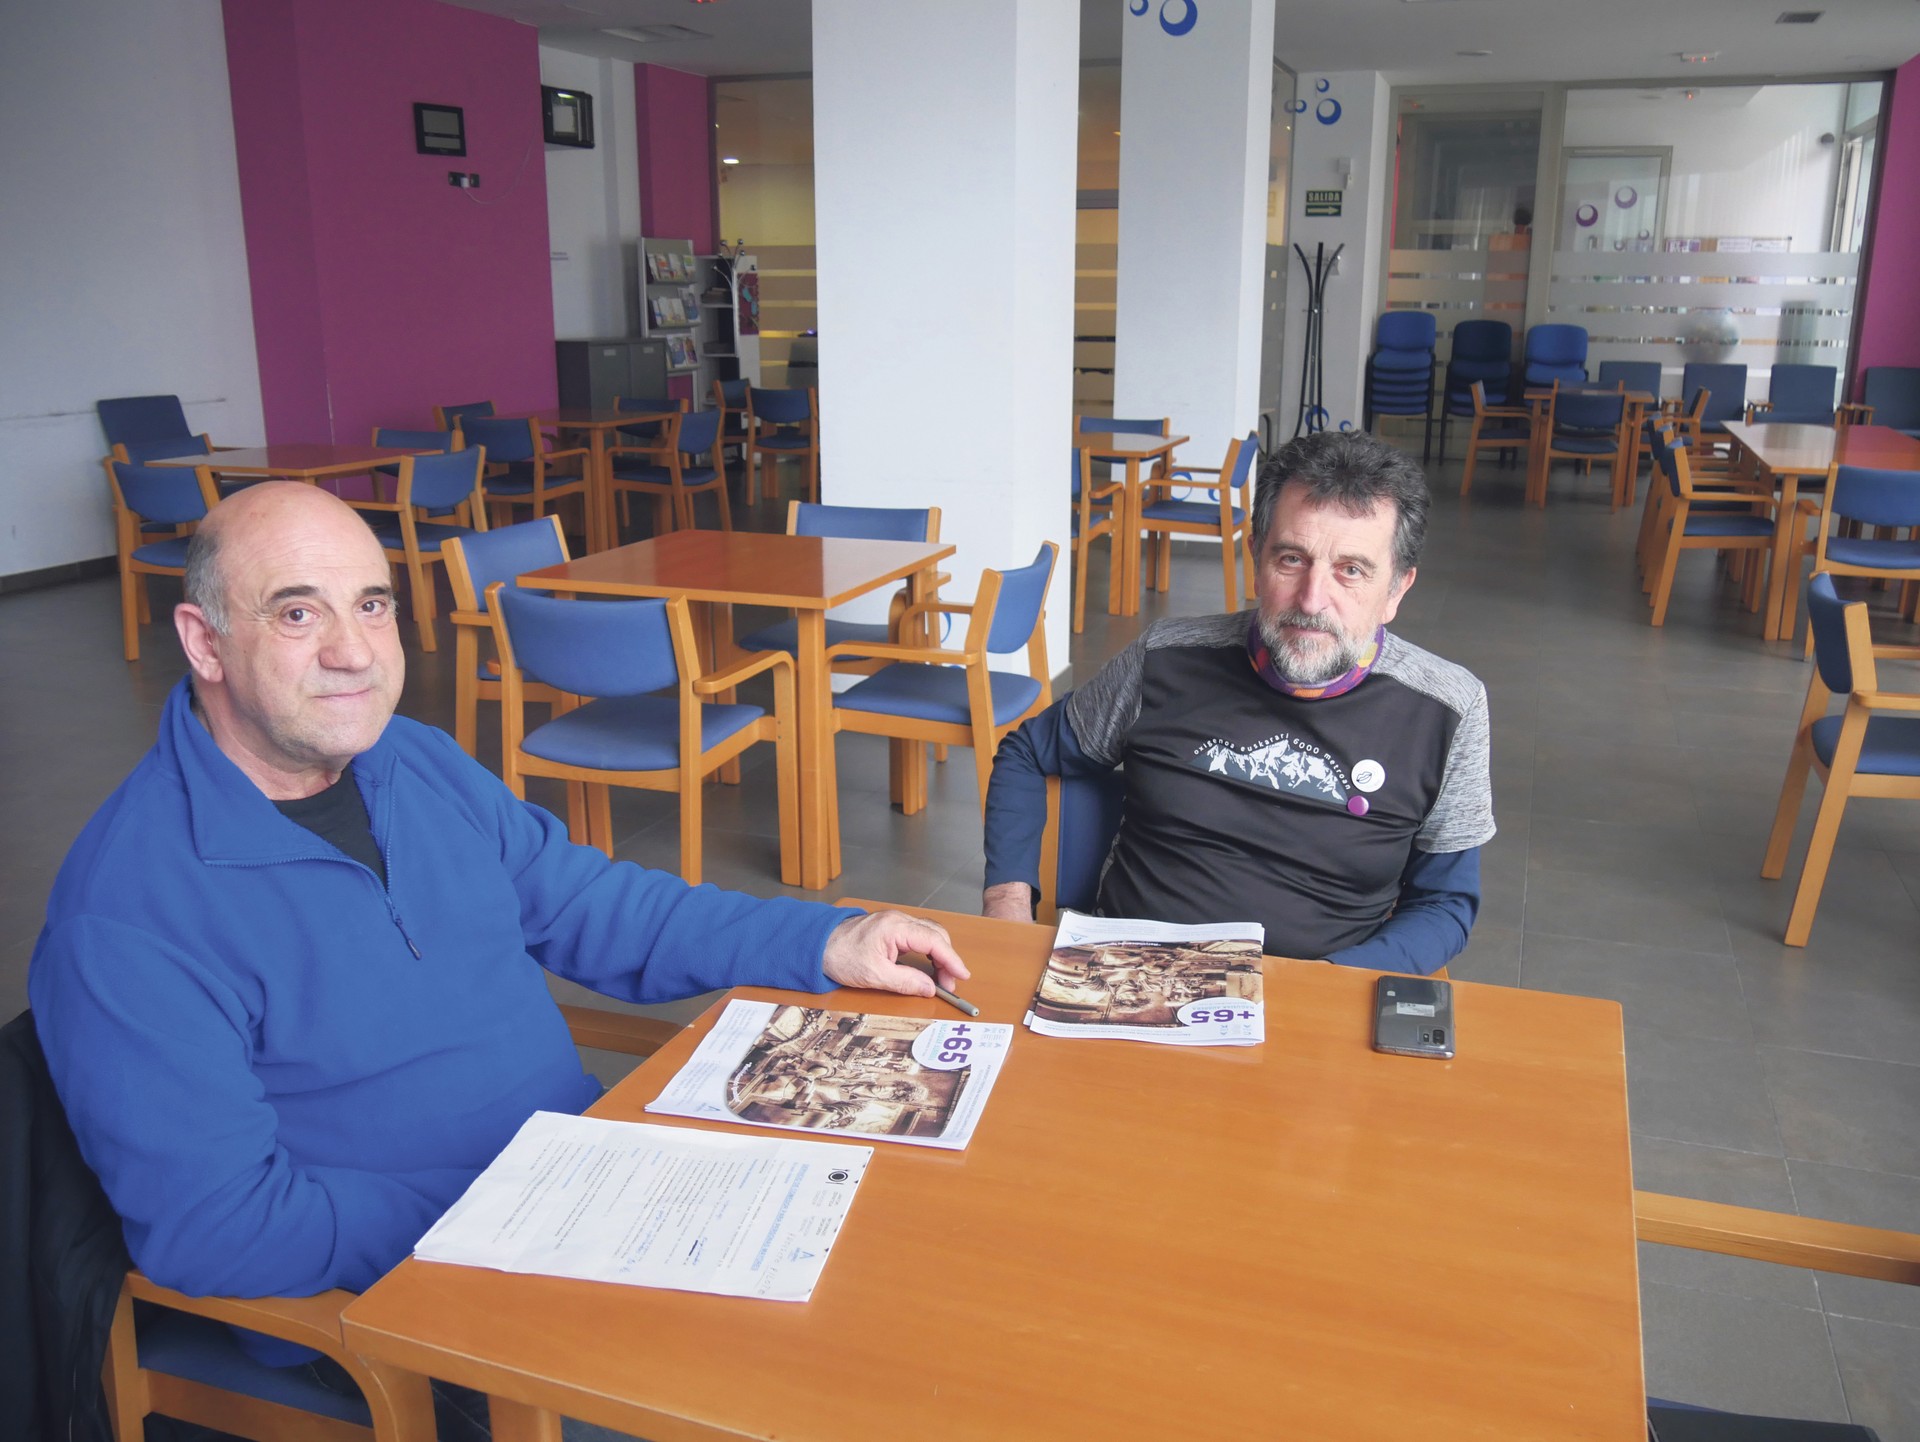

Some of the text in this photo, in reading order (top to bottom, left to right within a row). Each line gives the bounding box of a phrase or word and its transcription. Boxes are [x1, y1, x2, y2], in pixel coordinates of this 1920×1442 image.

[1308, 191, 1340, 201] SALIDA
[1194, 738, 1235, 755] oxigenoa
[1293, 738, 1320, 755] 6000
[1323, 752, 1351, 790] metroan
[1190, 1009, 1255, 1024] +65
[938, 1023, 972, 1063] +65
